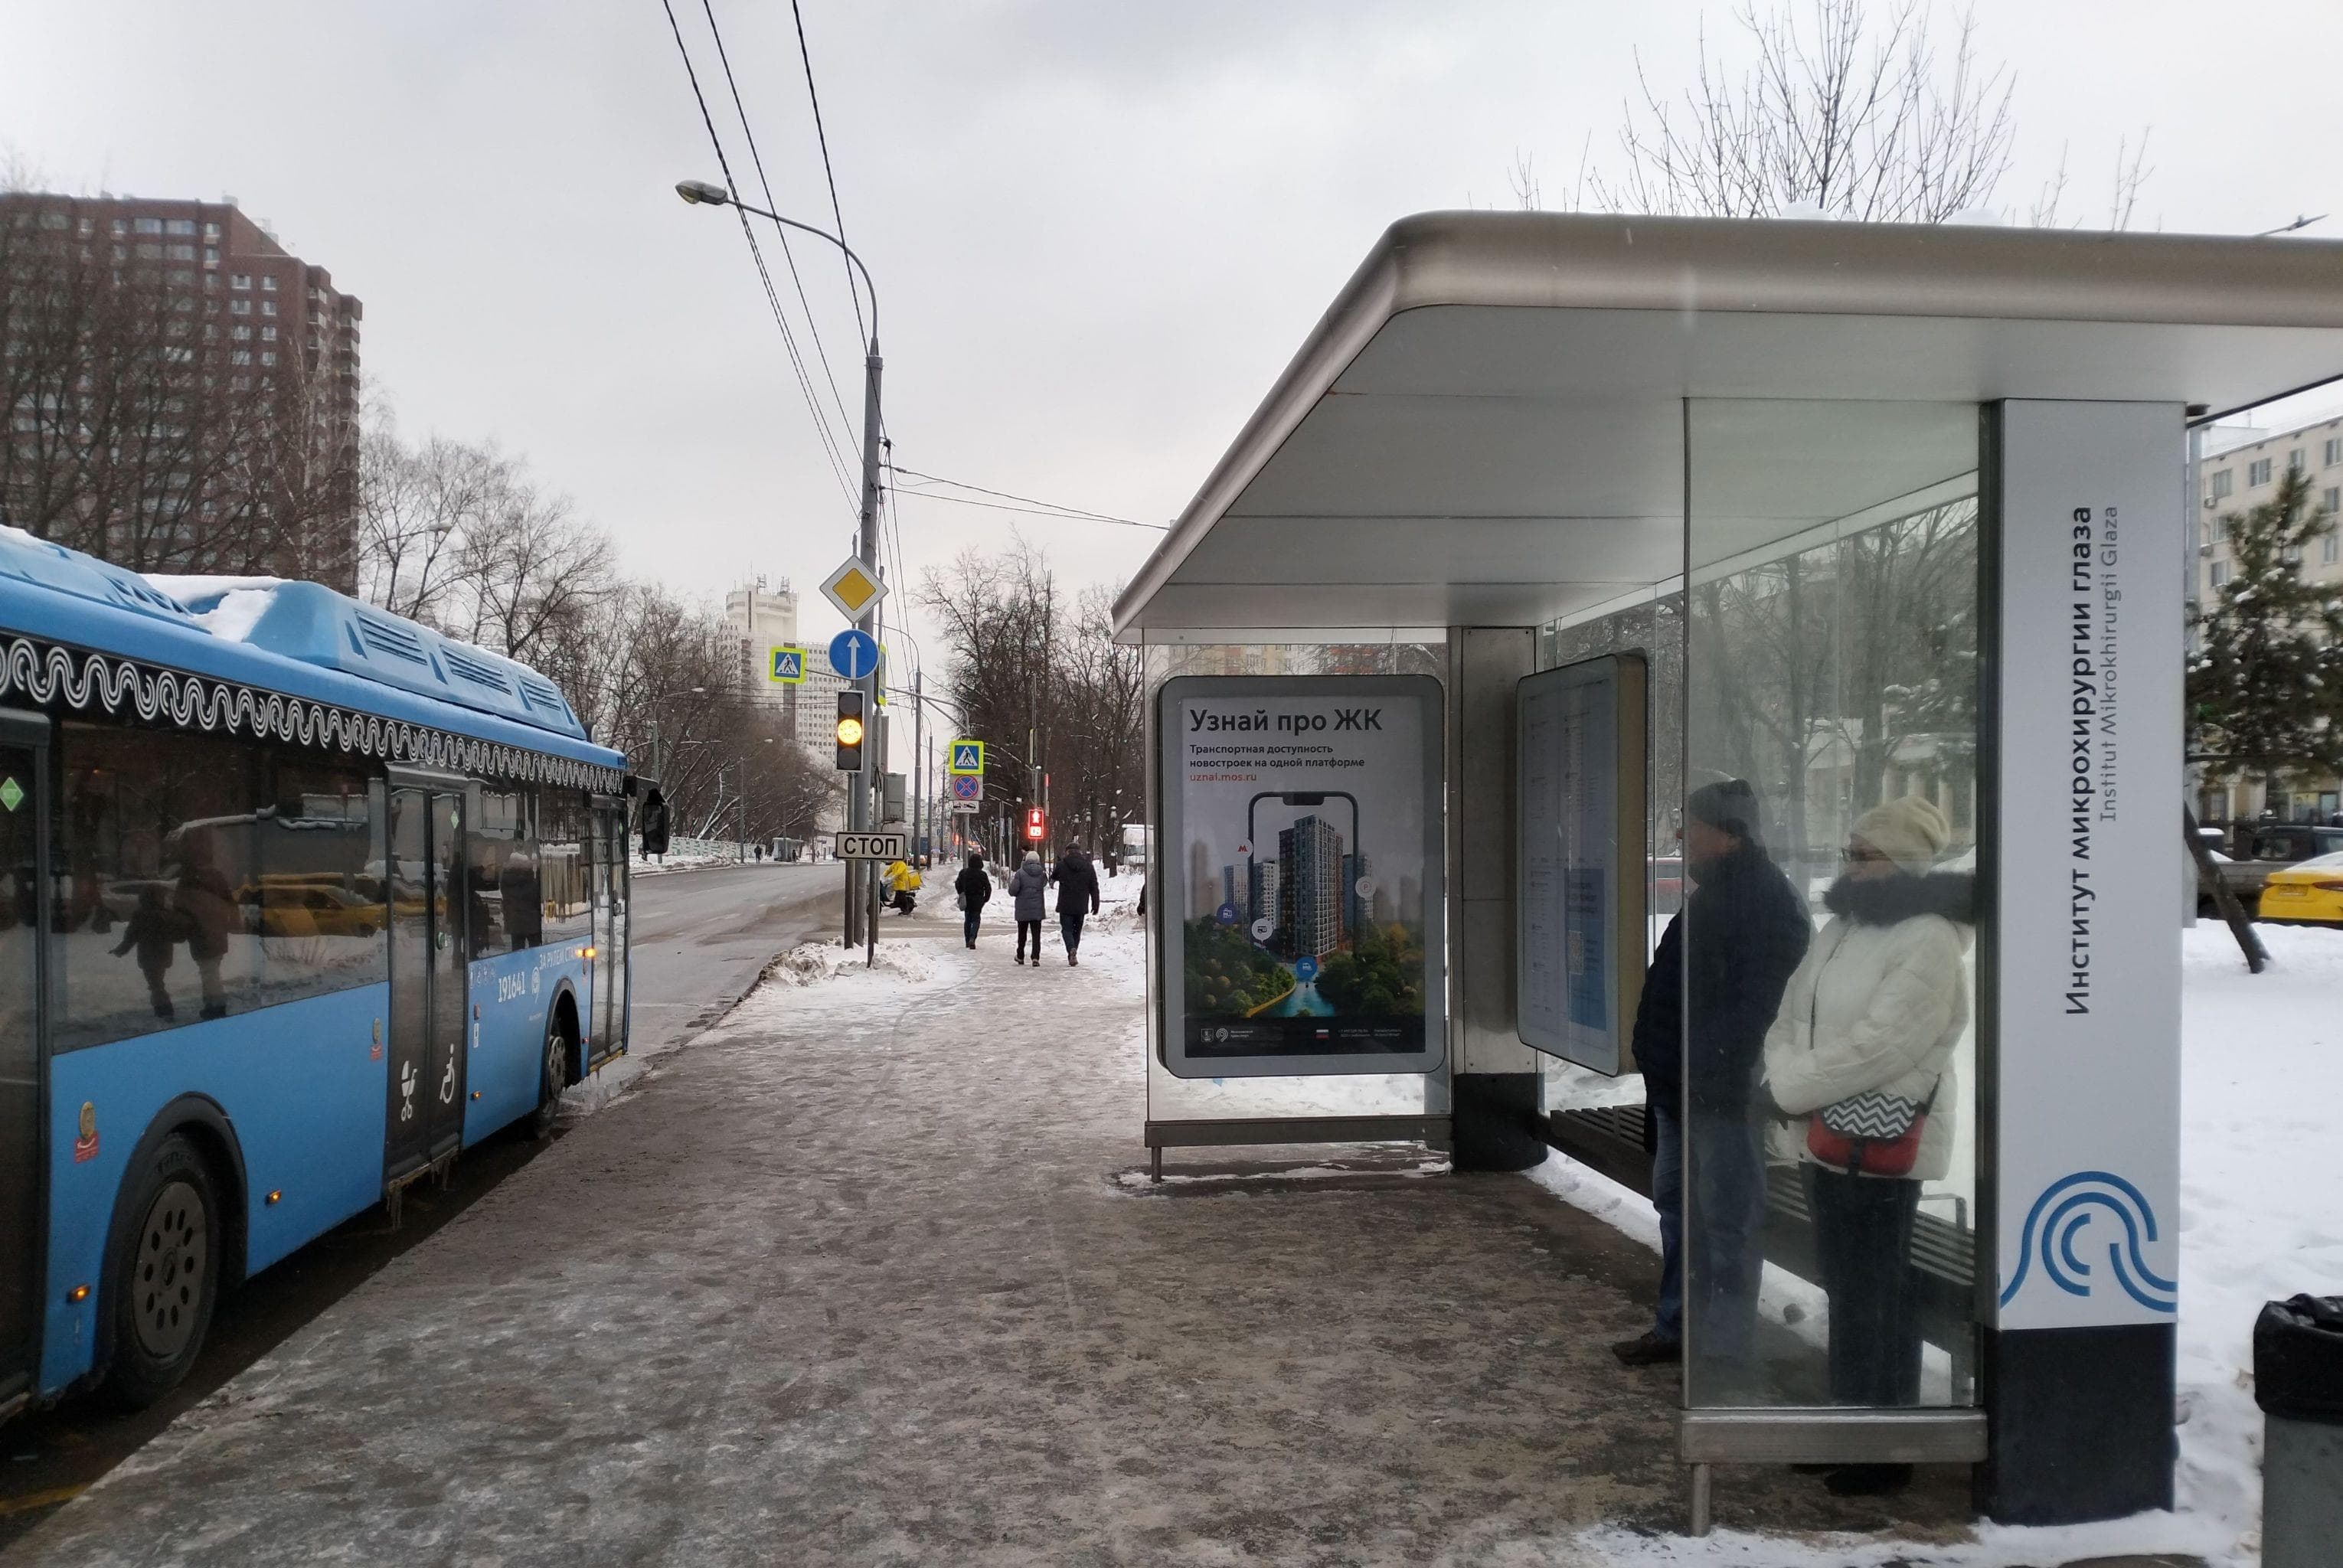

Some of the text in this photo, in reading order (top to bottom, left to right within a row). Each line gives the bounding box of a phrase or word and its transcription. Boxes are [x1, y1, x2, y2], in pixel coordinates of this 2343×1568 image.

[2100, 506, 2122, 822] Institut Mikrokhirurgii Glaza
[1189, 708, 1383, 737] Узнай про ЖК
[1189, 744, 1334, 756] Транспортная доступность
[2065, 507, 2096, 1014] Институт микрохирургии глаза
[1190, 756, 1366, 769] новостроек на одной платформе
[1190, 772, 1257, 782] uznai.mos.ru
[844, 837, 897, 856] СТОП
[498, 971, 526, 1003] 191641
